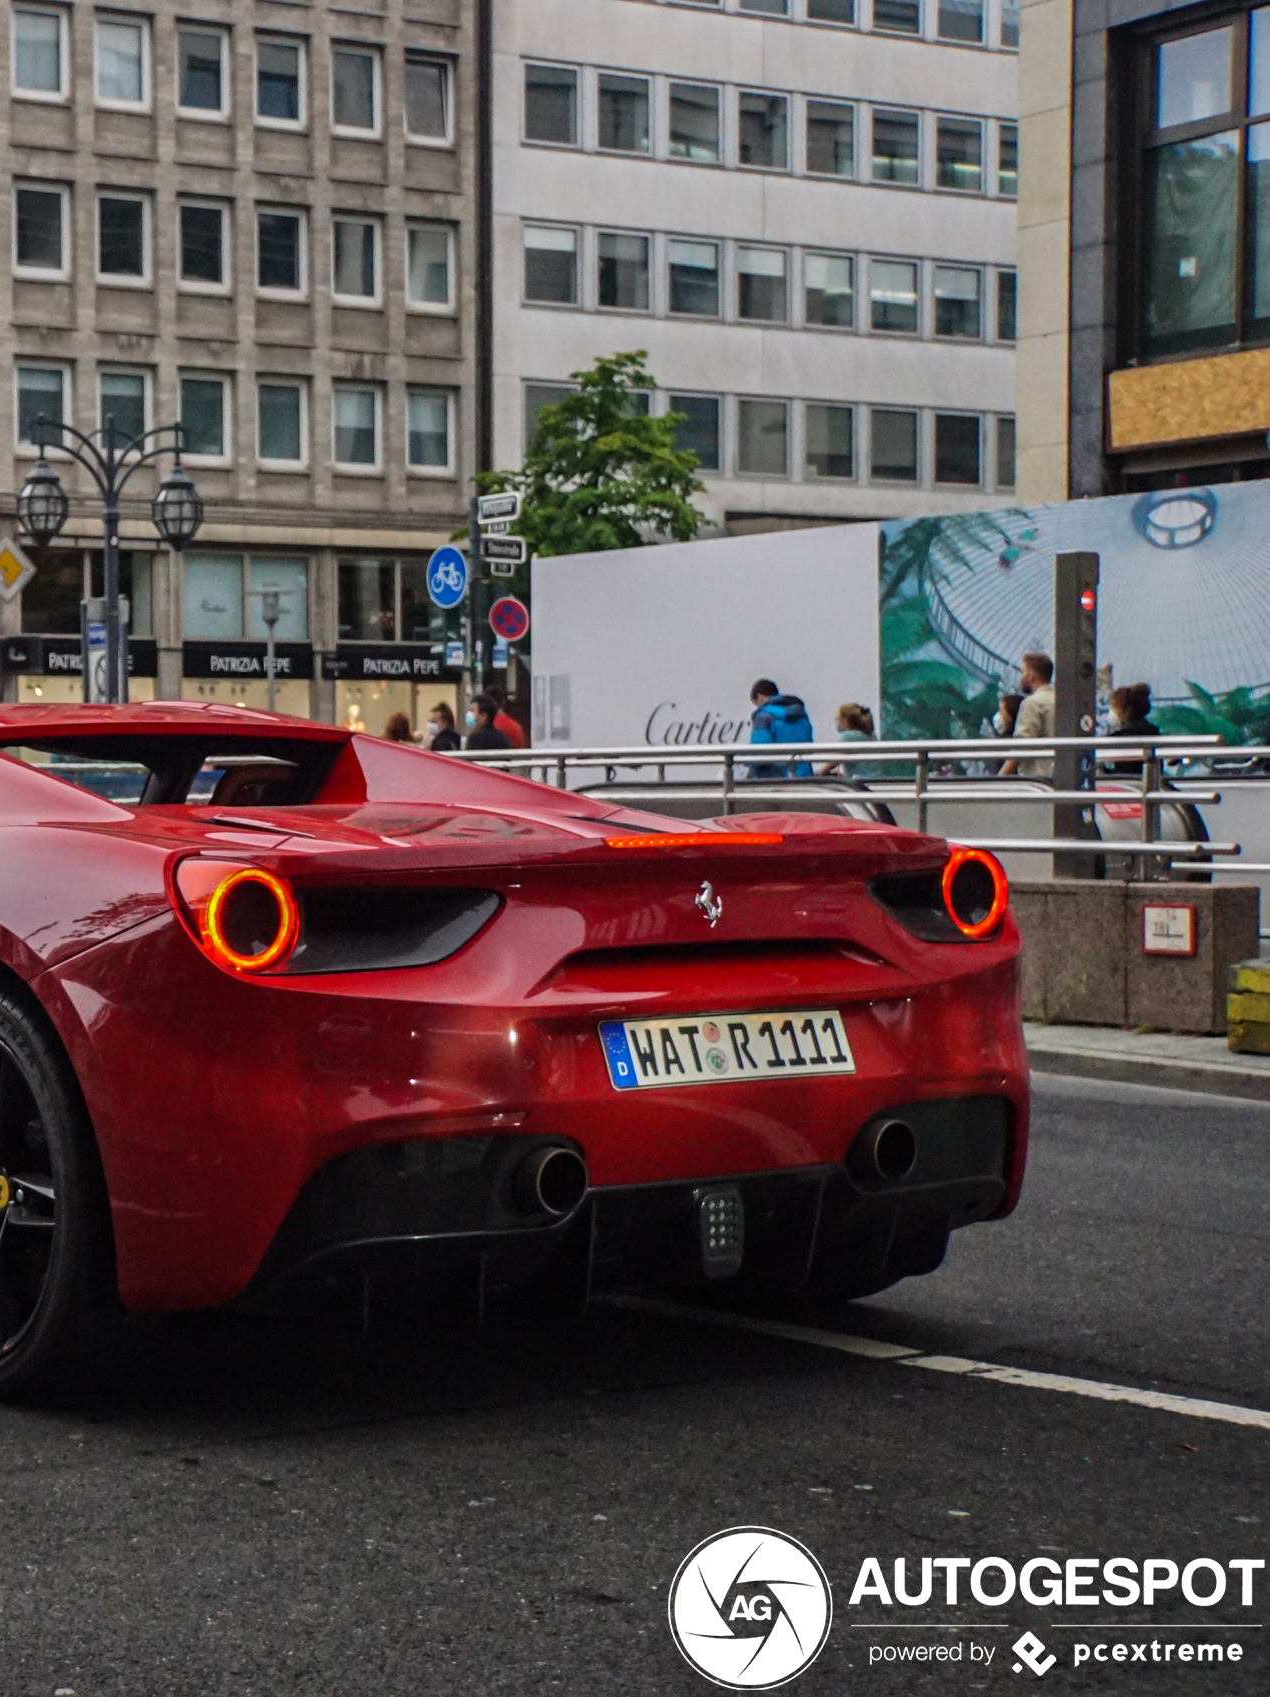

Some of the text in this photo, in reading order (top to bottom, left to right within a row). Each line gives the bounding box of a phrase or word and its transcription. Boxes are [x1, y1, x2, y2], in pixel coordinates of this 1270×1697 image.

[49, 652, 83, 670] PATRI
[210, 655, 260, 673] PATRIZIA
[363, 658, 410, 675] PATRIZIA
[413, 658, 440, 675] PEPE
[645, 701, 751, 746] Cartier
[630, 1025, 703, 1077] WAT
